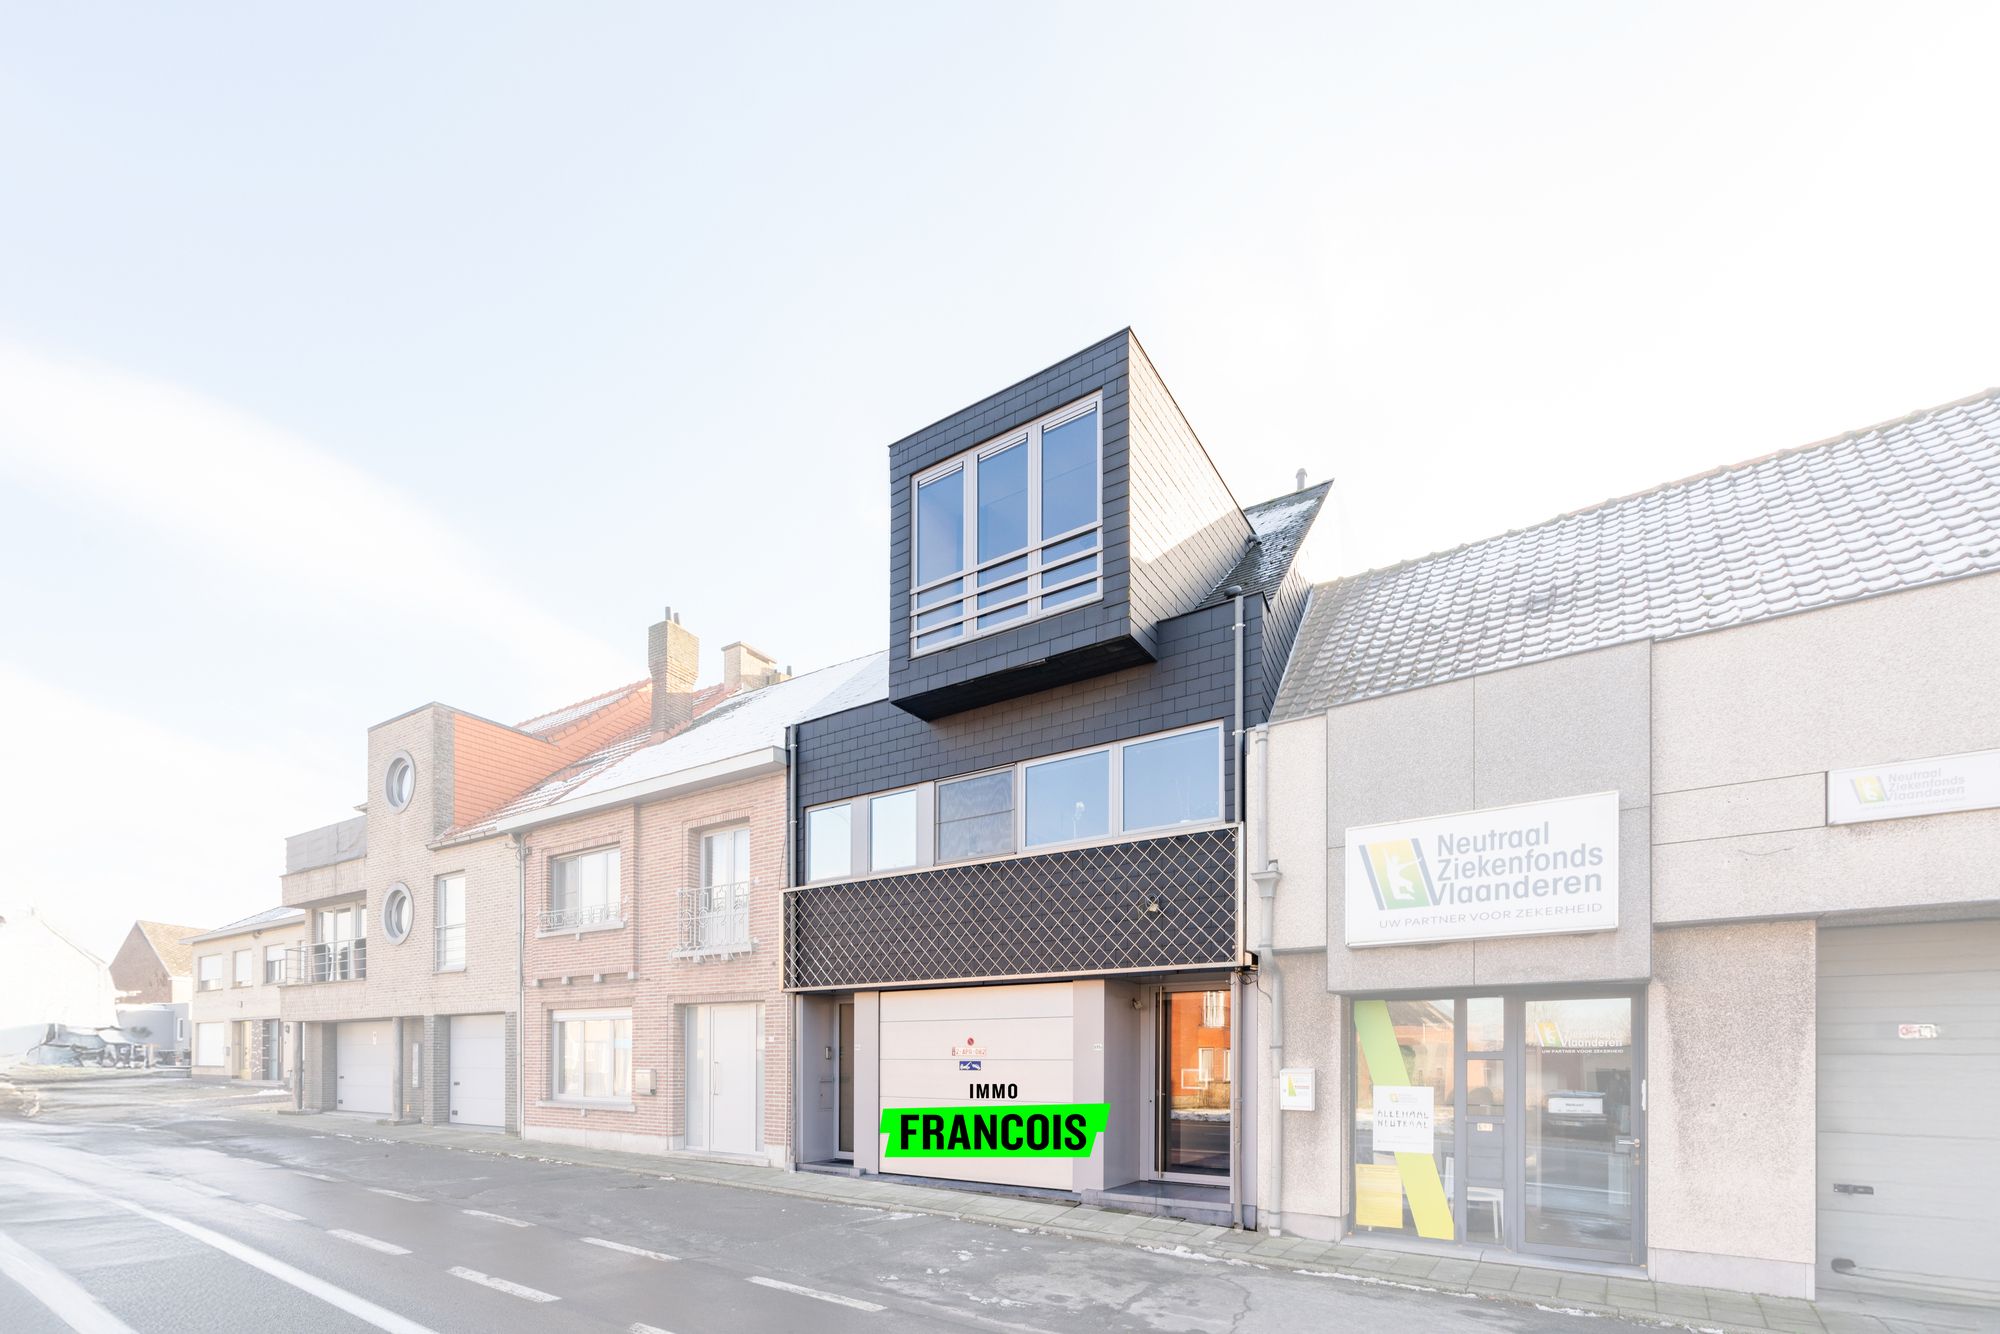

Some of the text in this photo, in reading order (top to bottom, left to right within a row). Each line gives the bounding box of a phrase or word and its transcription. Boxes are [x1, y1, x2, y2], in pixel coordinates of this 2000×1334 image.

[1888, 768, 1942, 783] Neutraal
[1888, 775, 1966, 792] Ziekenfonds
[1888, 786, 1965, 801] Vlaanderen
[1437, 821, 1550, 857] Neutraal
[1437, 846, 1603, 882] Ziekenfonds
[1431, 872, 1602, 906] Vlaanderen
[1379, 902, 1603, 929] UW PARTNER VOOR ZEKERHEID
[1560, 1038, 1623, 1047] Vlaanderen
[1377, 1119, 1428, 1129] NEUTRAAL
